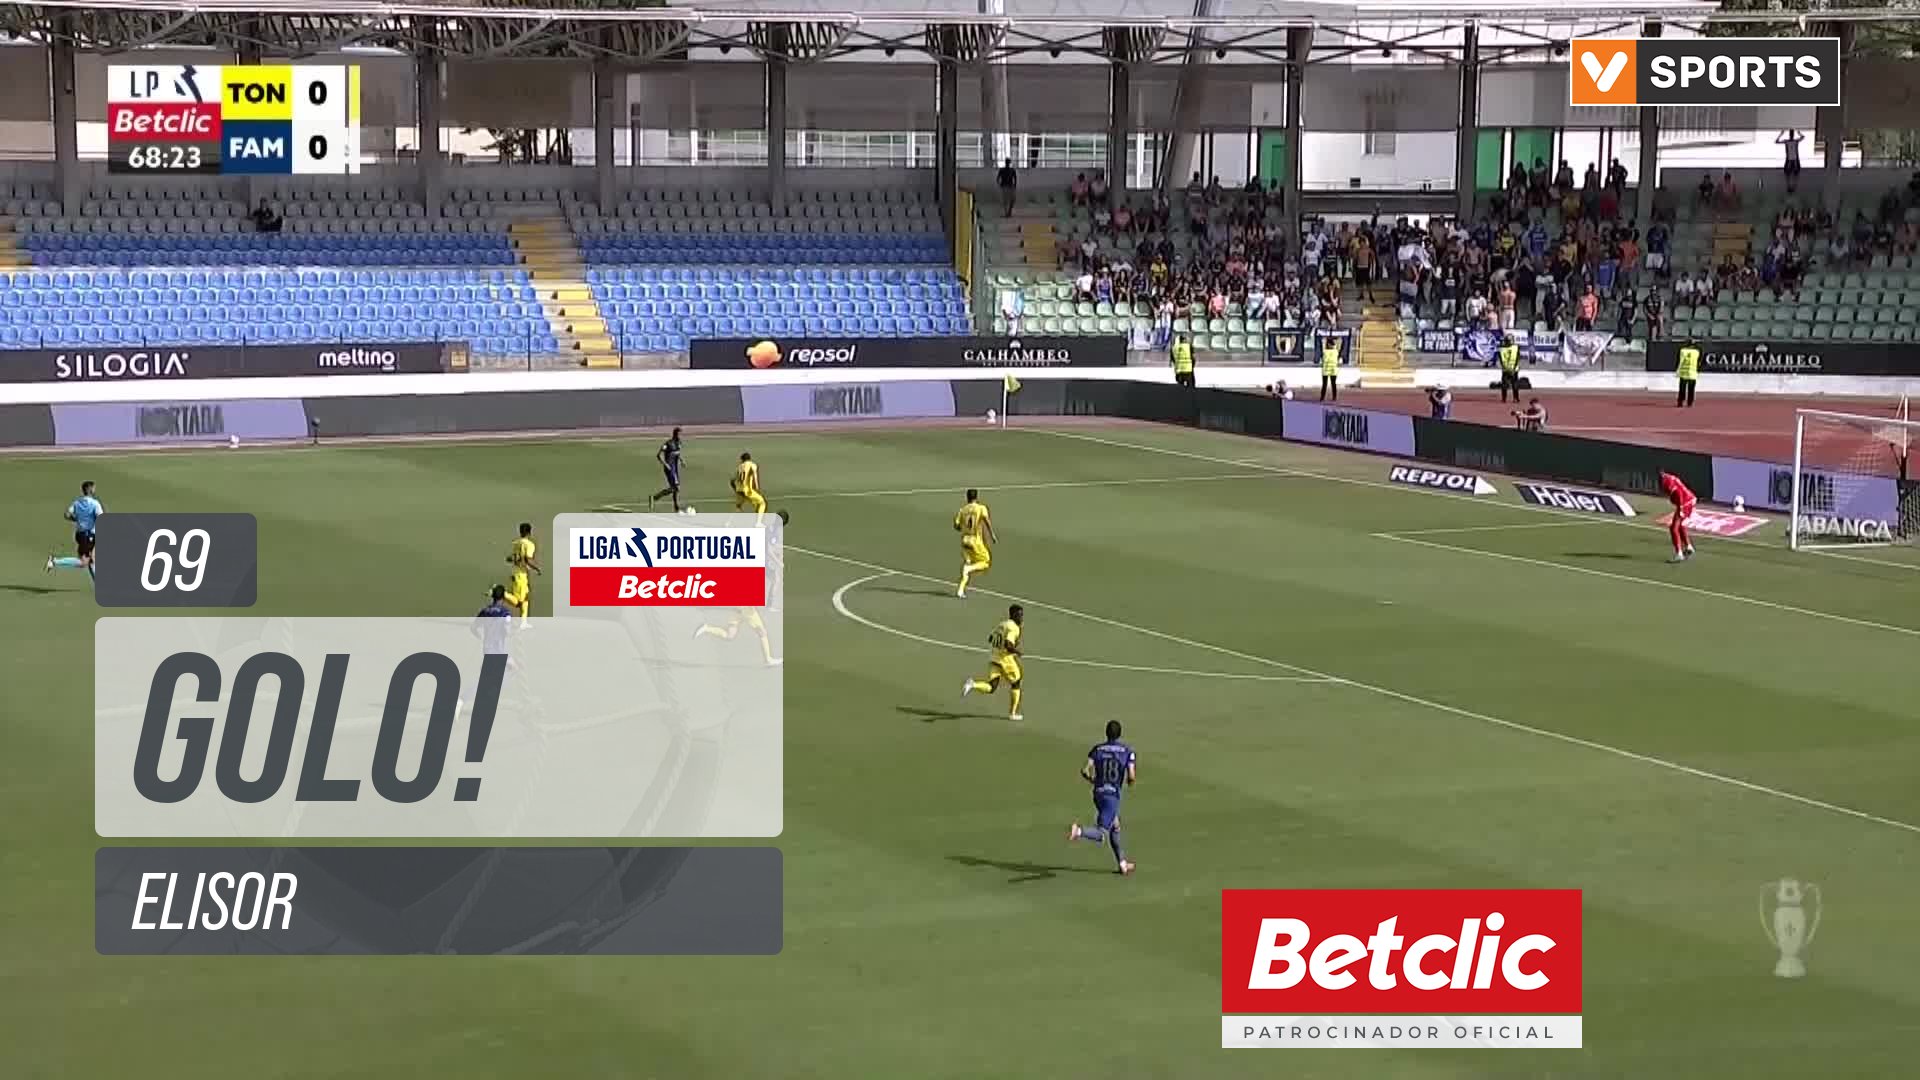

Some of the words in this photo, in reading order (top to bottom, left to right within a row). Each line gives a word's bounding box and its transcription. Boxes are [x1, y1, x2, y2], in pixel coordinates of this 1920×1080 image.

[789, 344, 855, 364] repsol
[1390, 466, 1475, 490] REPSOL
[1530, 486, 1606, 512] Haier
[1798, 515, 1893, 539] ABANCA
[1103, 758, 1119, 783] 18
